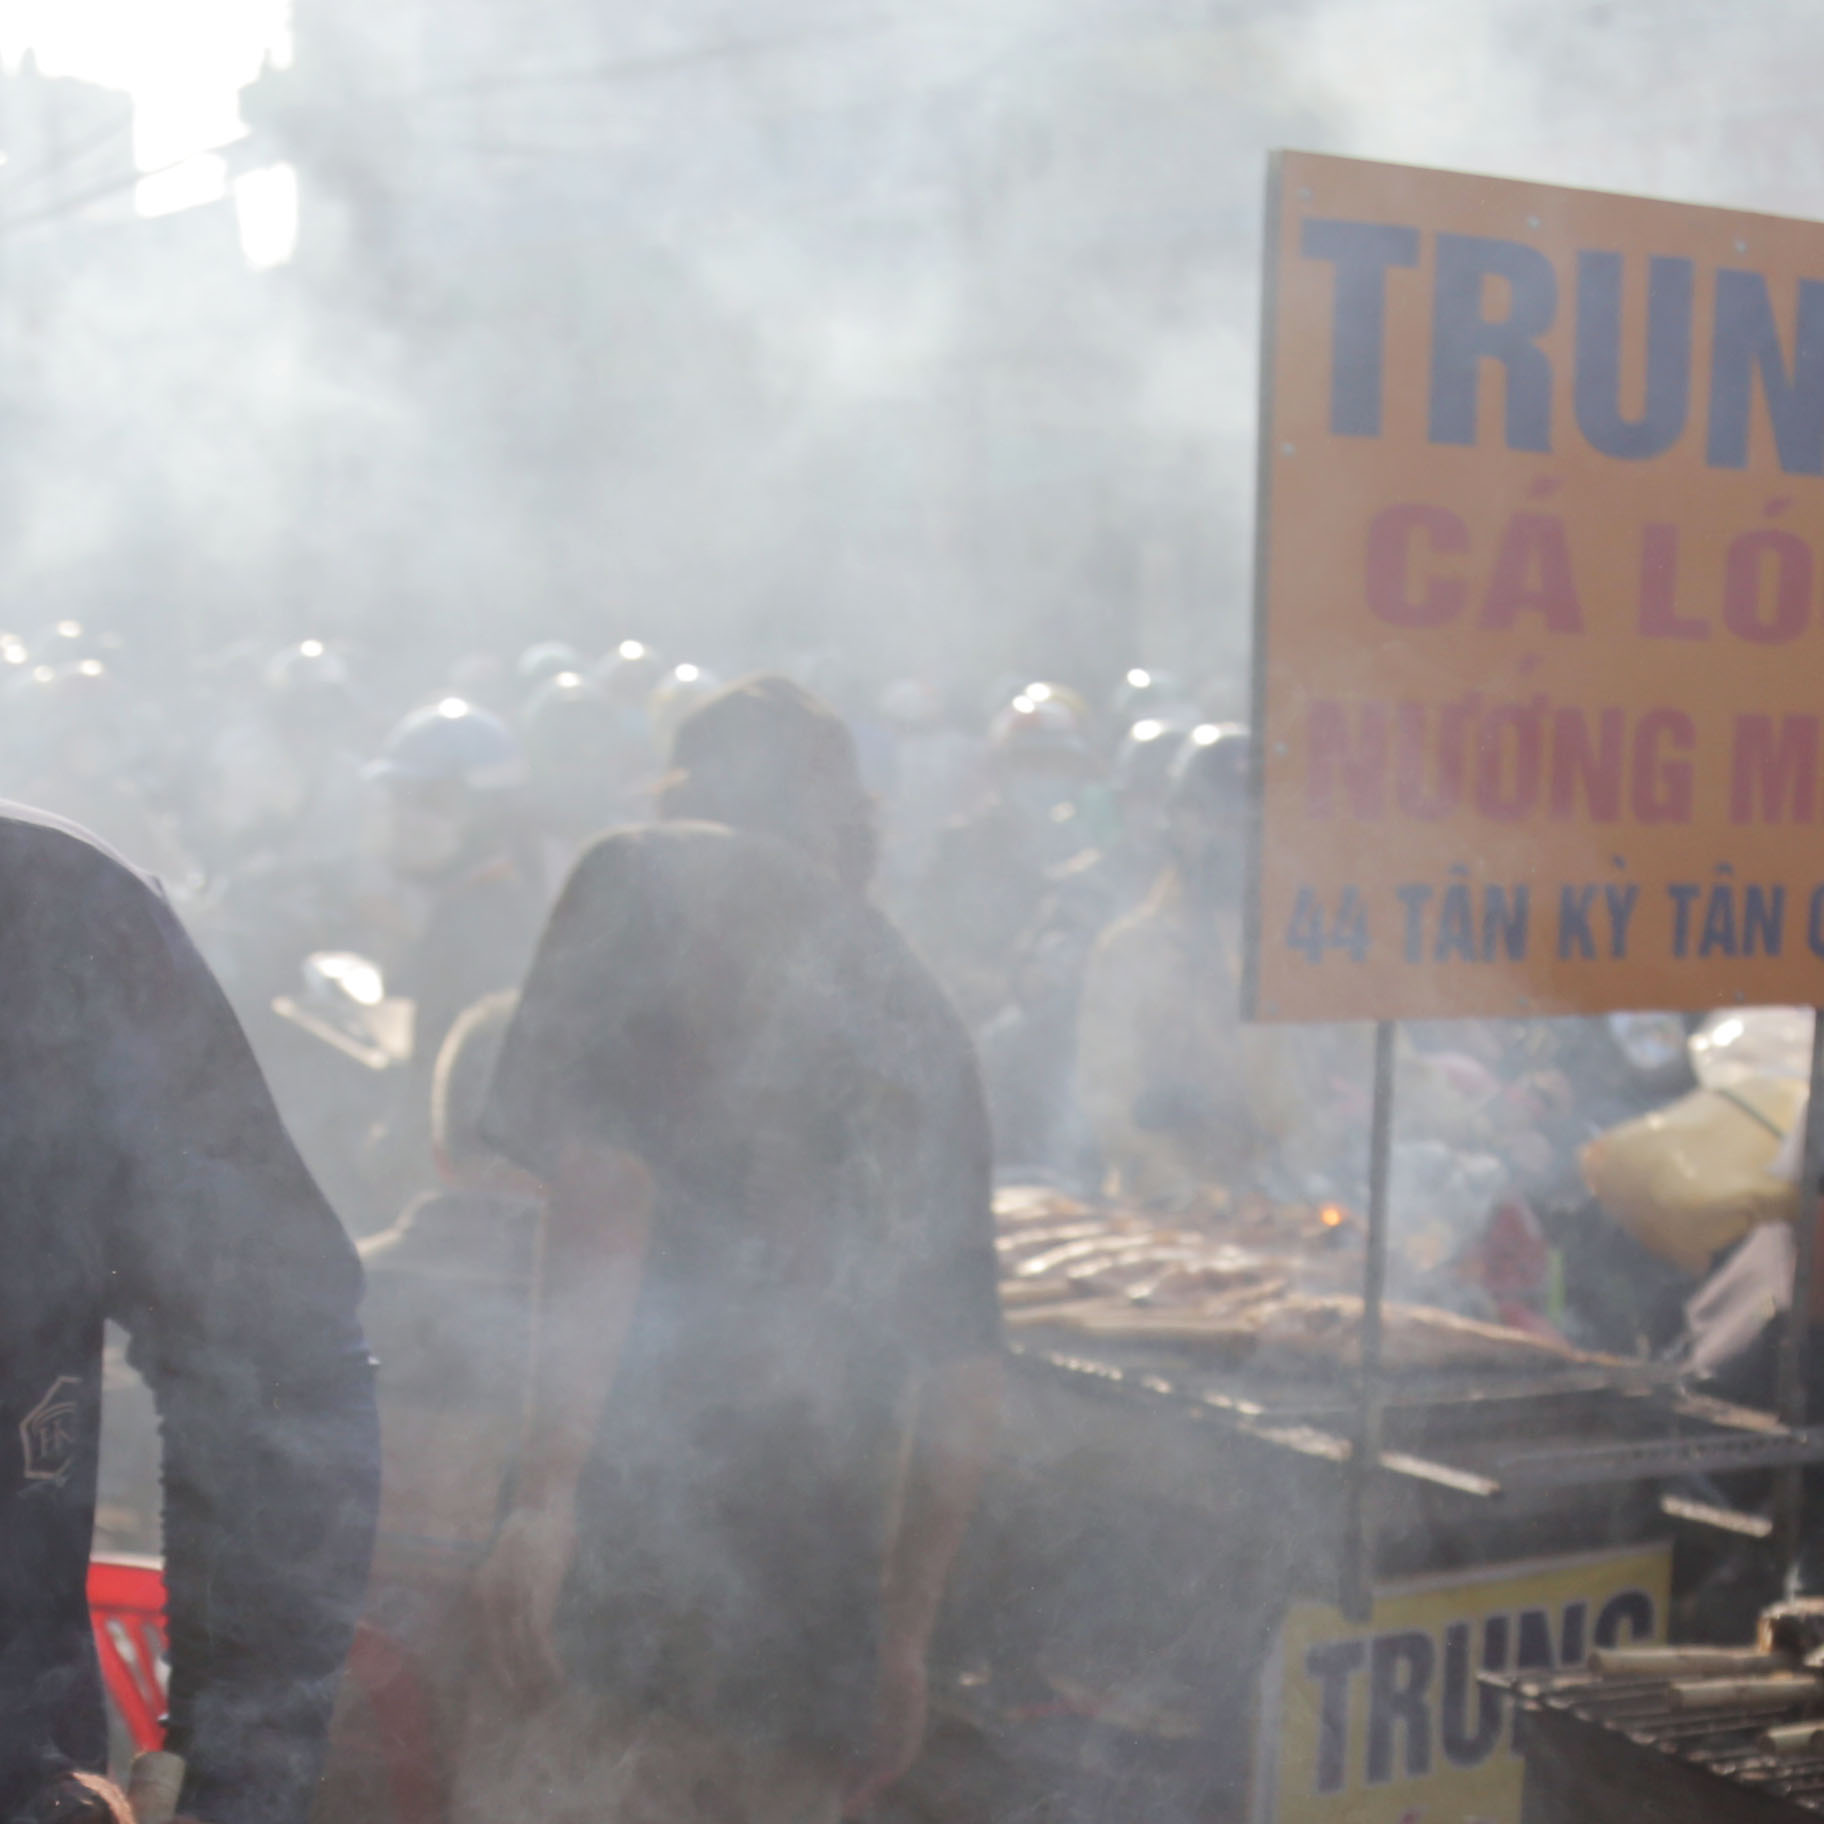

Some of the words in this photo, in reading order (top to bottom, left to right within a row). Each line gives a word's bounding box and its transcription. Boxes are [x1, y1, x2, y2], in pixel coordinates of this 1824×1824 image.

[1363, 475, 1585, 636] CÁ
[1305, 652, 1696, 827] NƯỚNG
[1283, 881, 1373, 966] 44
[1394, 864, 1530, 965] TÂN
[1556, 854, 1641, 961] KỲ
[1667, 861, 1788, 960] TÂN
